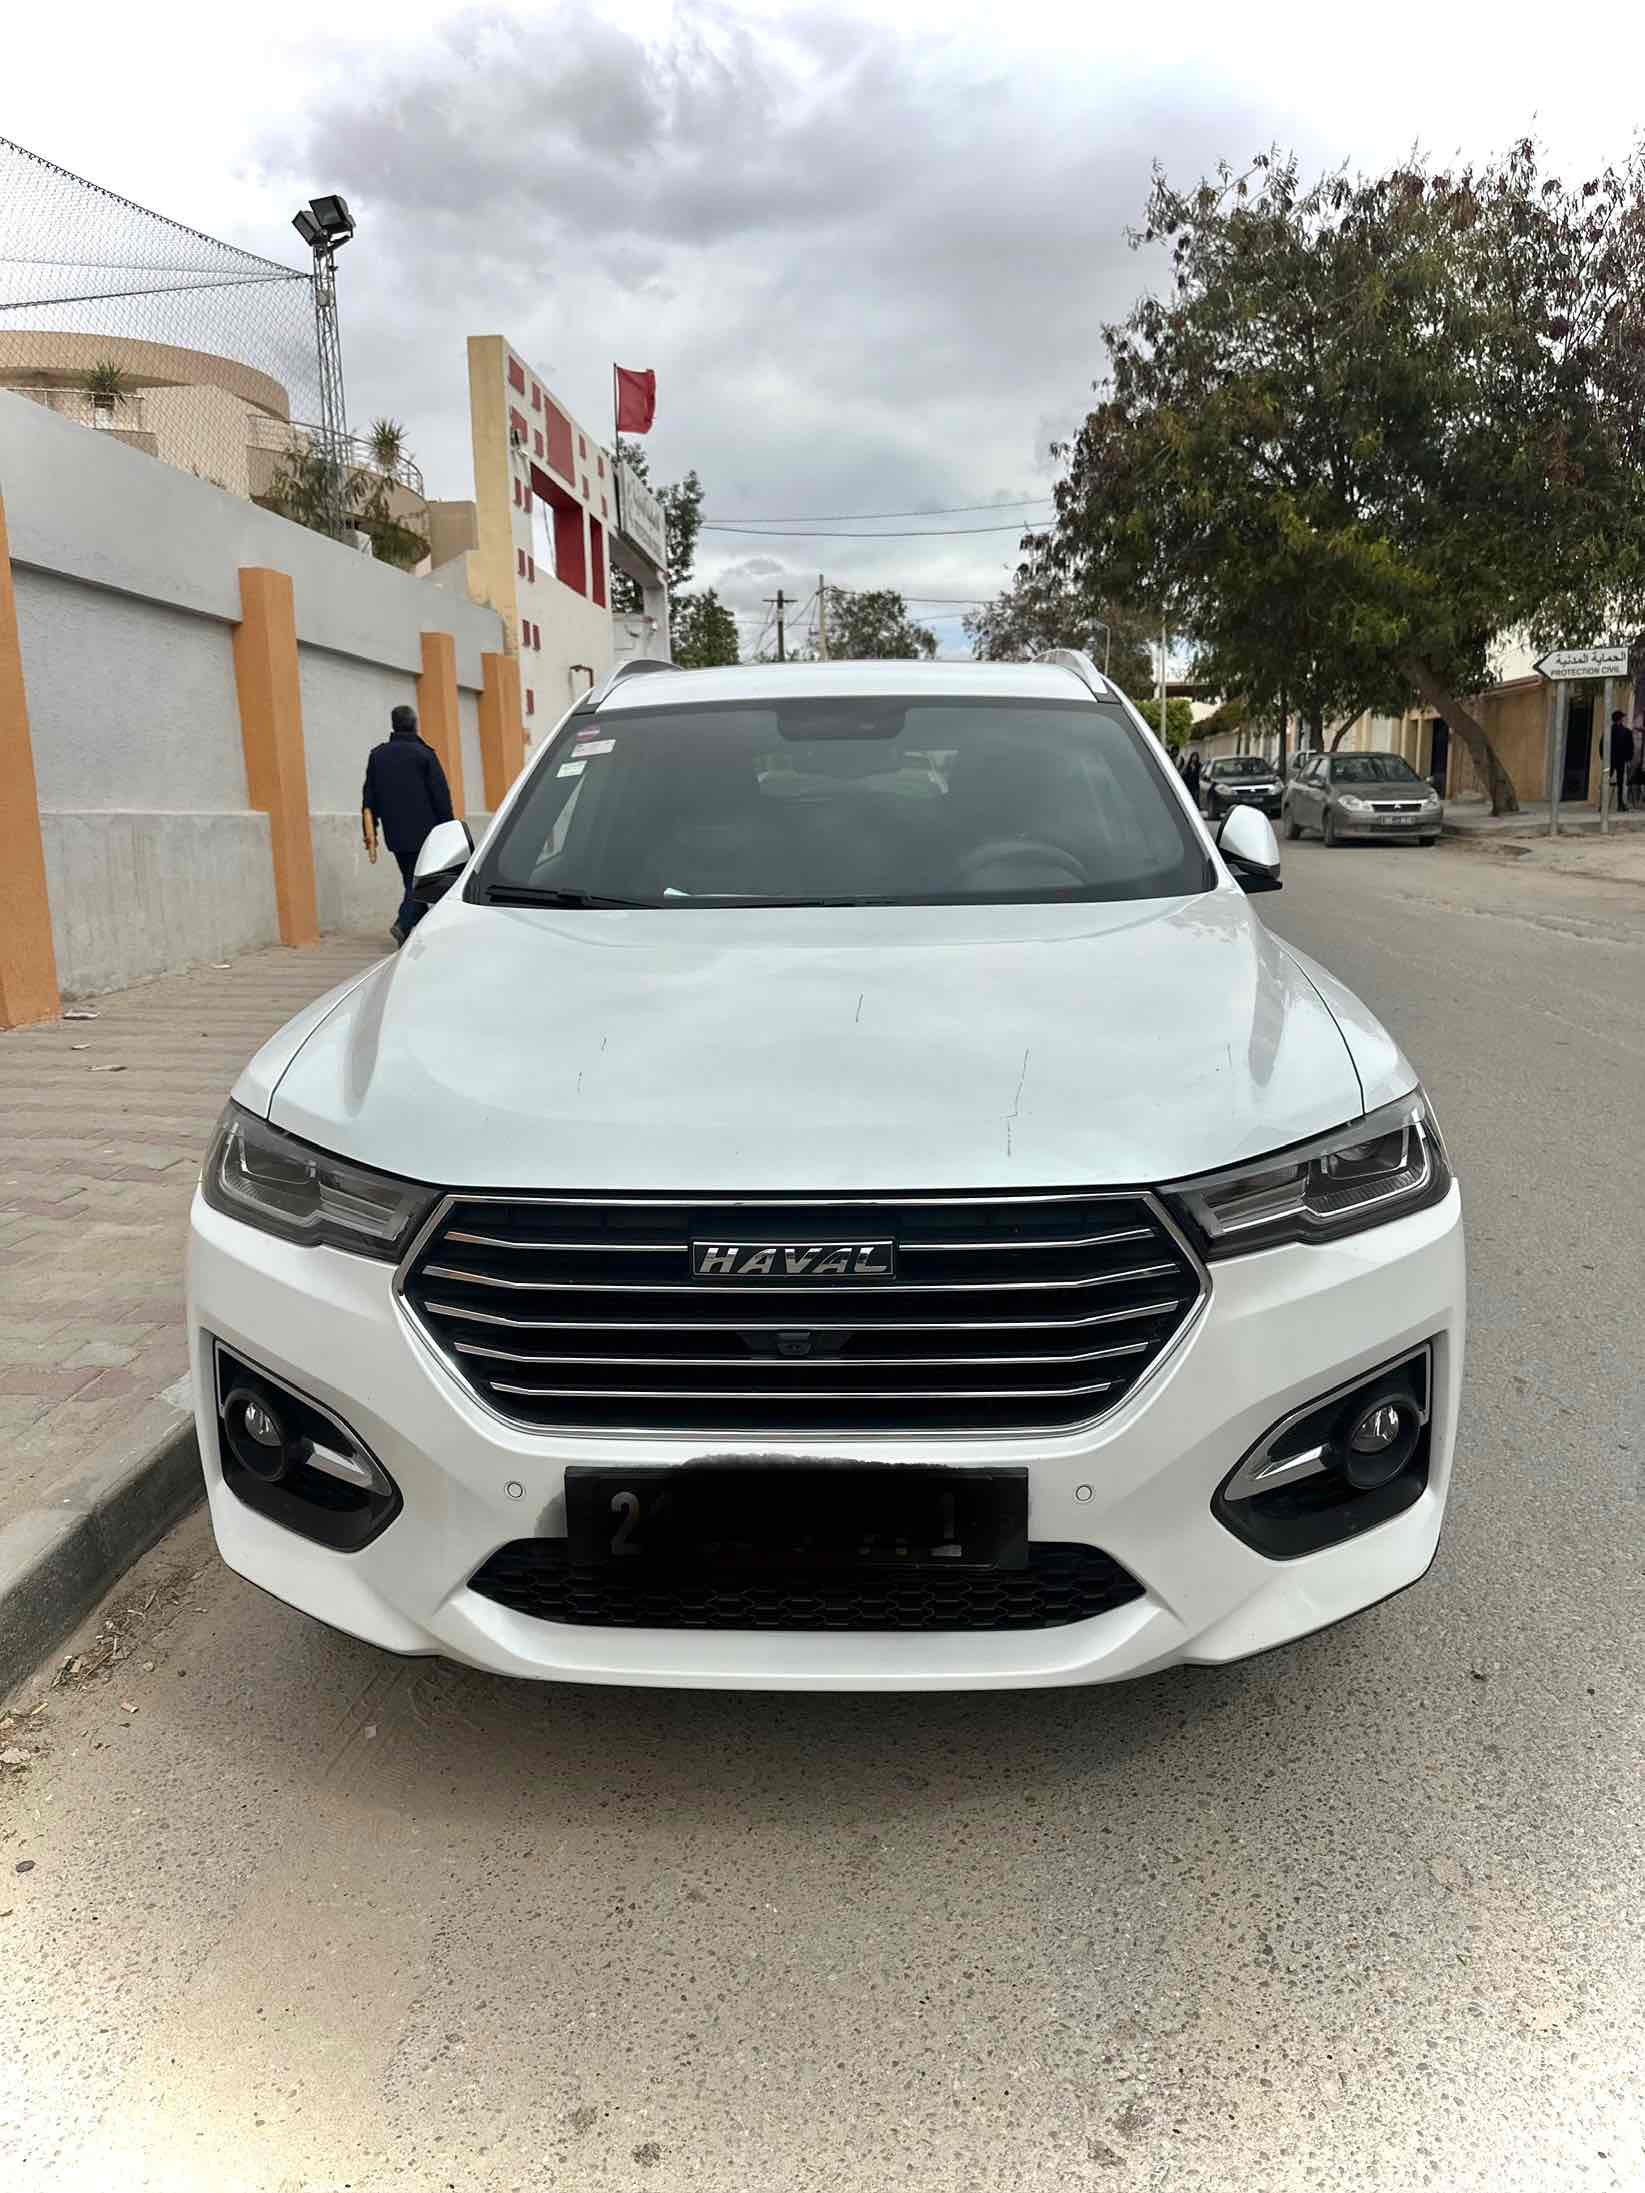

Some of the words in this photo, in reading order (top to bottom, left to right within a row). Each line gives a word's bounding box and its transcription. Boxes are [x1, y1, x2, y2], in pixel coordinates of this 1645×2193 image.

[1555, 653, 1589, 668] المدنية
[1591, 651, 1626, 667] الحماية
[1551, 668, 1600, 676] PROTECTION
[1601, 666, 1620, 674] CIVIL
[699, 1247, 888, 1274] HAVAL
